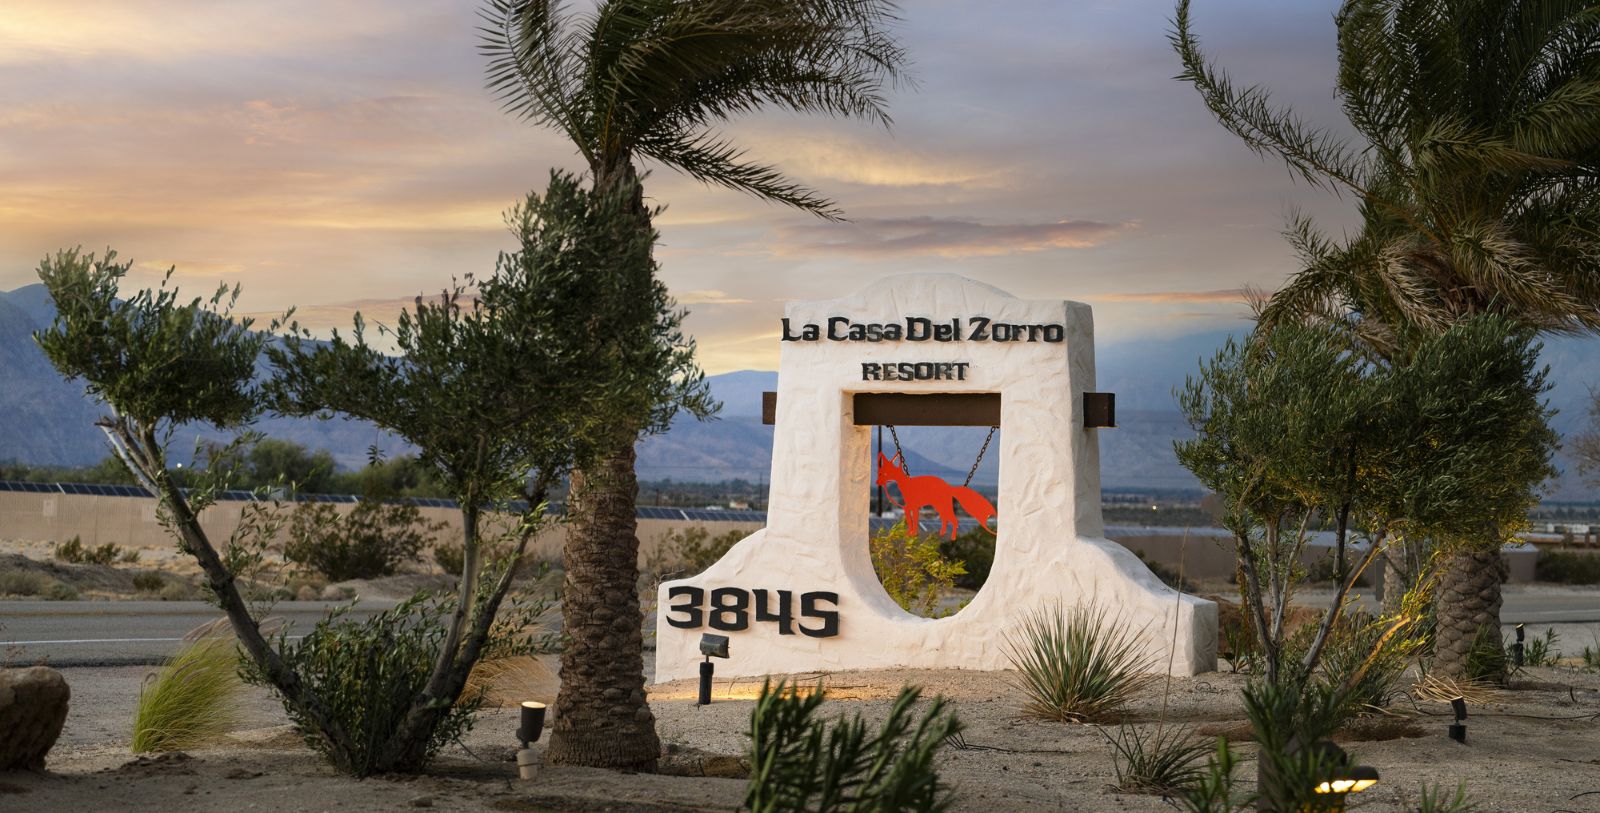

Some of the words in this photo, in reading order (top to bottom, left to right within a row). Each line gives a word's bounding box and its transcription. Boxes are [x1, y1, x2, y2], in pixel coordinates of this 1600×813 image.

[781, 317, 820, 342] La
[827, 316, 902, 343] Casa
[905, 316, 961, 343] Del
[967, 317, 1064, 343] Zorro
[861, 362, 969, 381] RESORT
[666, 586, 839, 638] 3845
